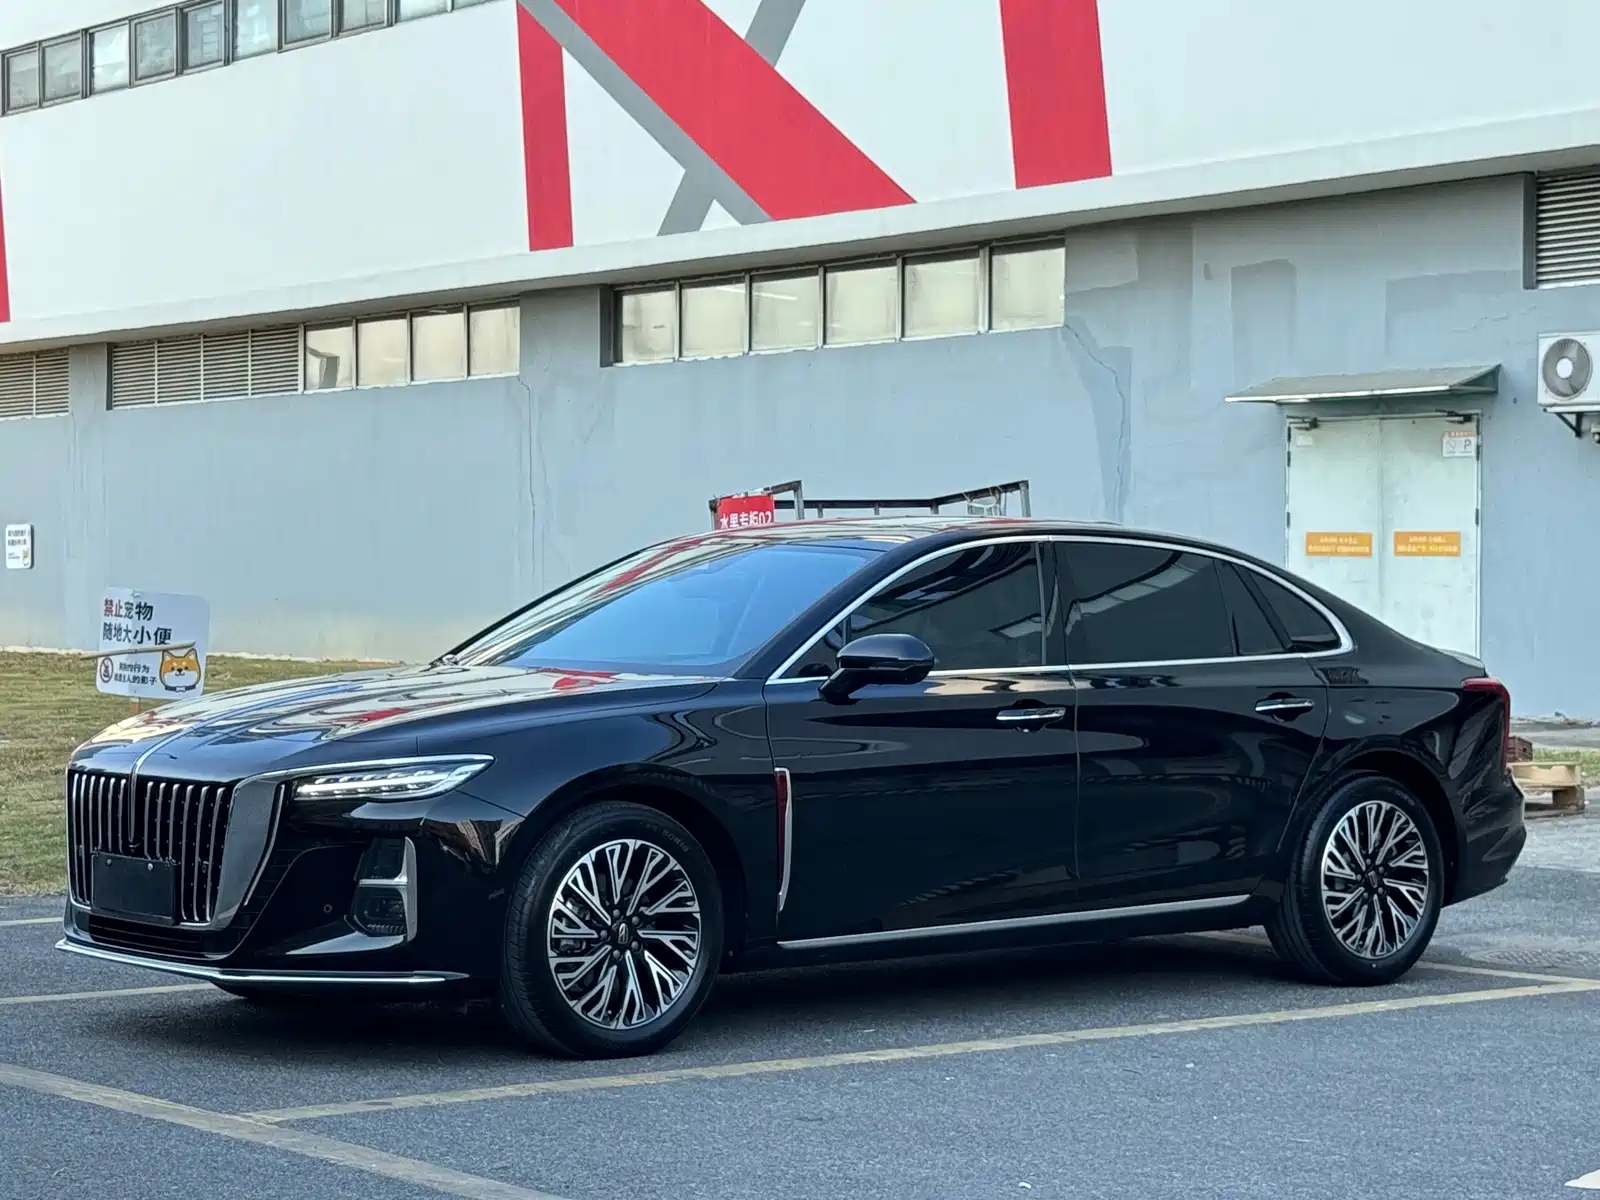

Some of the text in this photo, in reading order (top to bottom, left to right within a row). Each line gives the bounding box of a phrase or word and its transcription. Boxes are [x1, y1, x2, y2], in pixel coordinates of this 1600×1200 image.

[103, 598, 154, 621] 禁止宠物
[102, 622, 172, 646] 随地大小便
